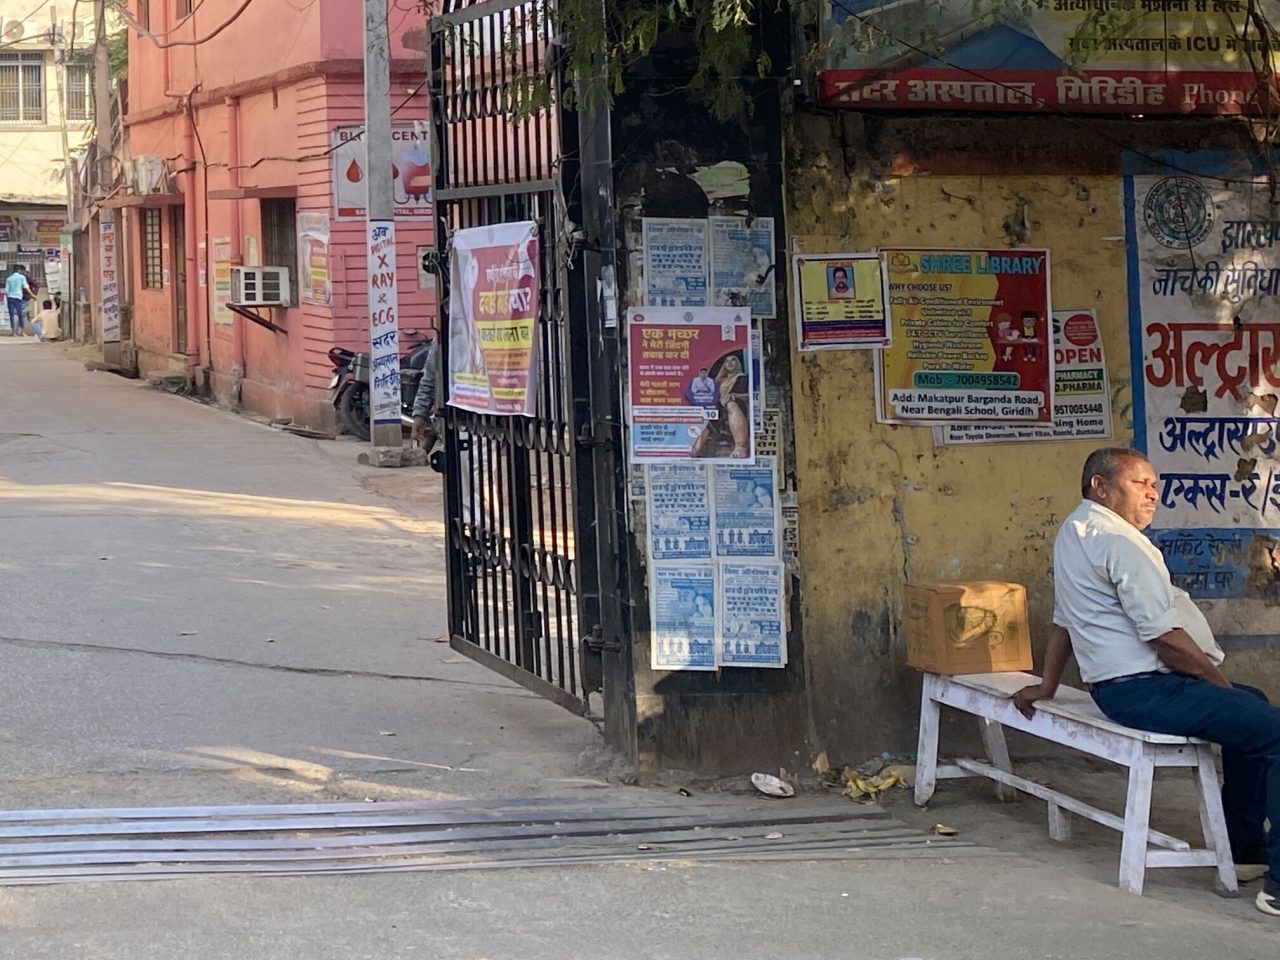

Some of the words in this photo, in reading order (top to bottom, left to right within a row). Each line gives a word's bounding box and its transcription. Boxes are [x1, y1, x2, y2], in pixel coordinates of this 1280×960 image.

[1187, 37, 1220, 52] ICU
[835, 80, 900, 102] सदर
[1056, 76, 1167, 105] गिरिडीह
[372, 227, 389, 241] अब
[377, 254, 389, 269] X
[921, 254, 972, 274] SHREE
[976, 254, 1042, 274] LIBRARY
[372, 272, 394, 290] RAY
[889, 283, 905, 292] WHY
[907, 283, 937, 292] CHOOSE
[939, 283, 952, 292] US?
[372, 307, 394, 327] ECG
[901, 319, 927, 327] Private
[953, 319, 963, 327] for
[965, 319, 994, 328] Comfort
[372, 331, 397, 349] सदर
[641, 329, 665, 339] एक
[923, 330, 942, 338] CCTV
[945, 341, 984, 349] Washroom
[1055, 347, 1102, 365] OPEN
[919, 375, 942, 385] Mob
[956, 375, 1018, 385] 7004958542
[892, 393, 916, 403] Add:
[918, 394, 965, 406] Makatpur
[967, 394, 1012, 406] Barganda
[1015, 394, 1042, 406] Road,
[901, 405, 926, 415] Near
[928, 405, 962, 416] Bengali
[965, 406, 999, 416] School,
[1001, 406, 1034, 416] Giridih
[1076, 418, 1103, 426] Home
